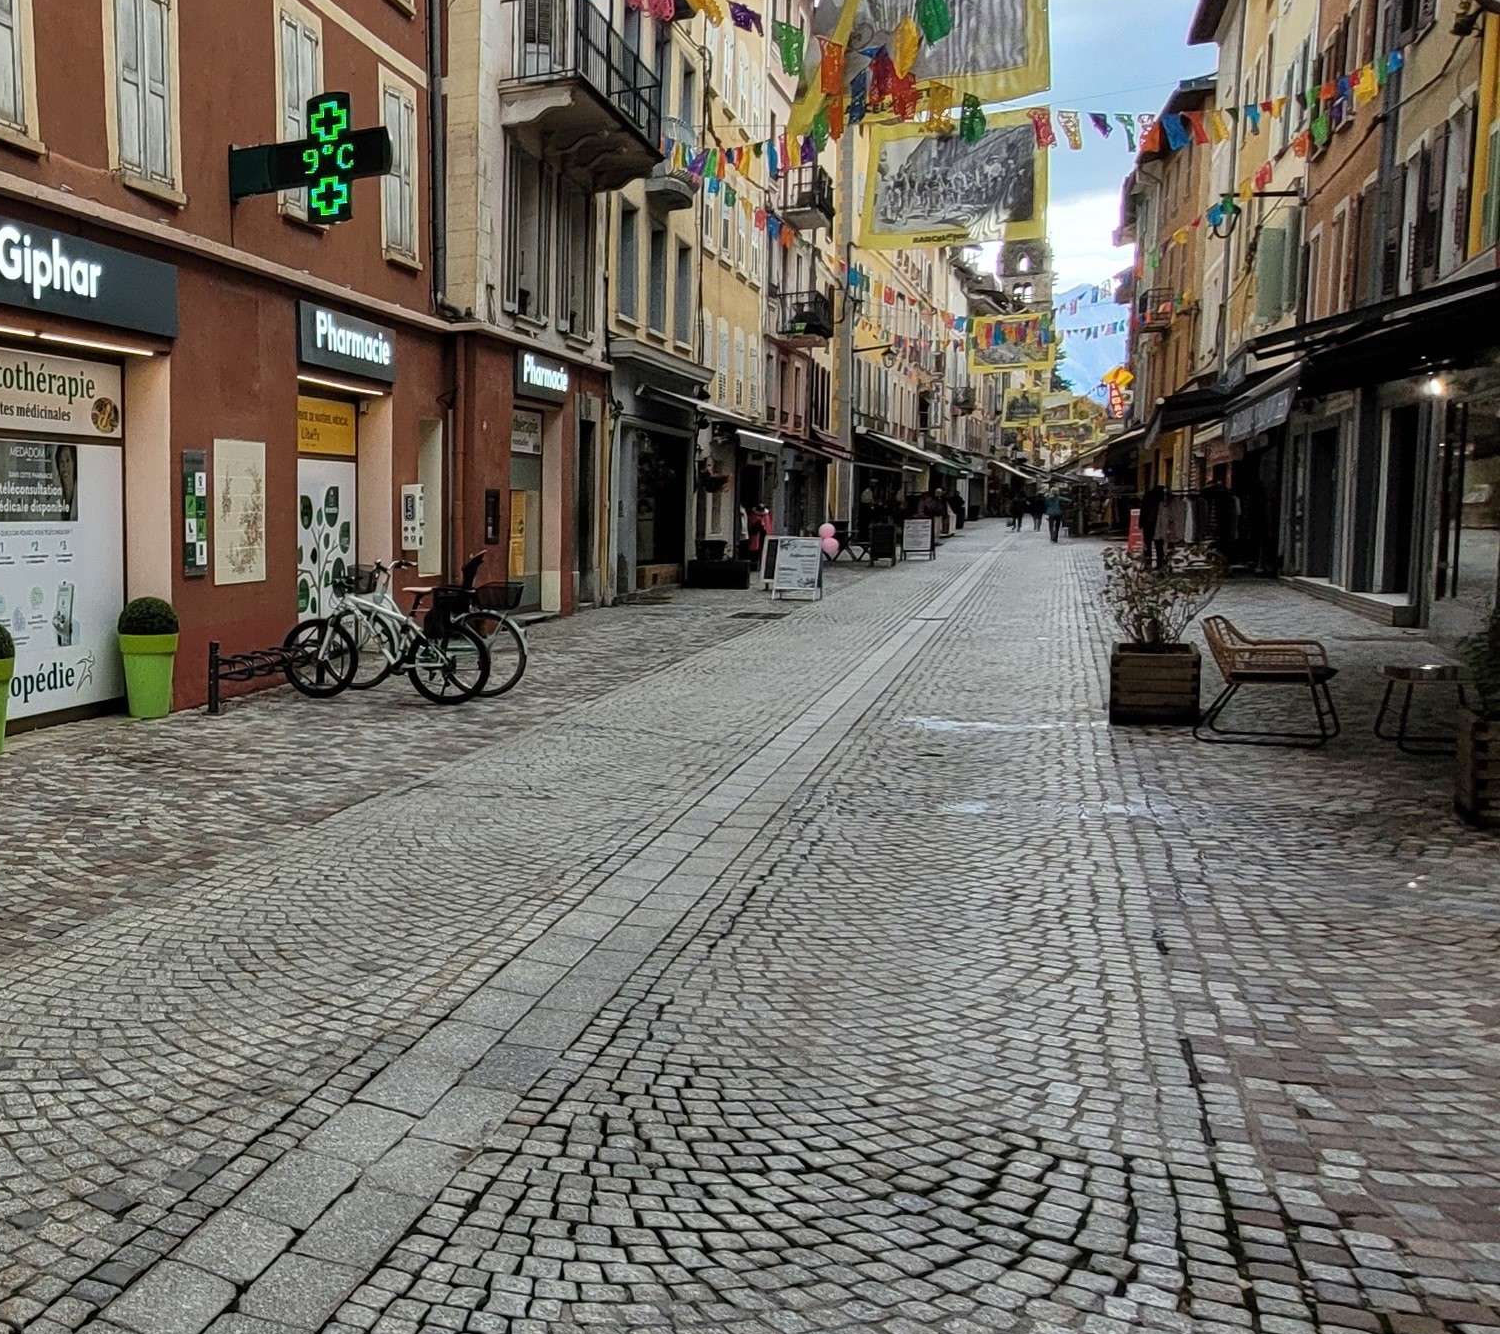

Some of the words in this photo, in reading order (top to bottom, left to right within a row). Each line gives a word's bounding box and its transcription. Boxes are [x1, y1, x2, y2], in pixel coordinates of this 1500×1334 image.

[302, 143, 354, 175] 9°C
[316, 310, 390, 365] Pharmacie
[523, 354, 568, 392] Pharmacie
[16, 403, 71, 422] médicinales
[0, 481, 63, 496] téléconsultation
[30, 499, 70, 516] disponible
[11, 662, 75, 704] opédie
